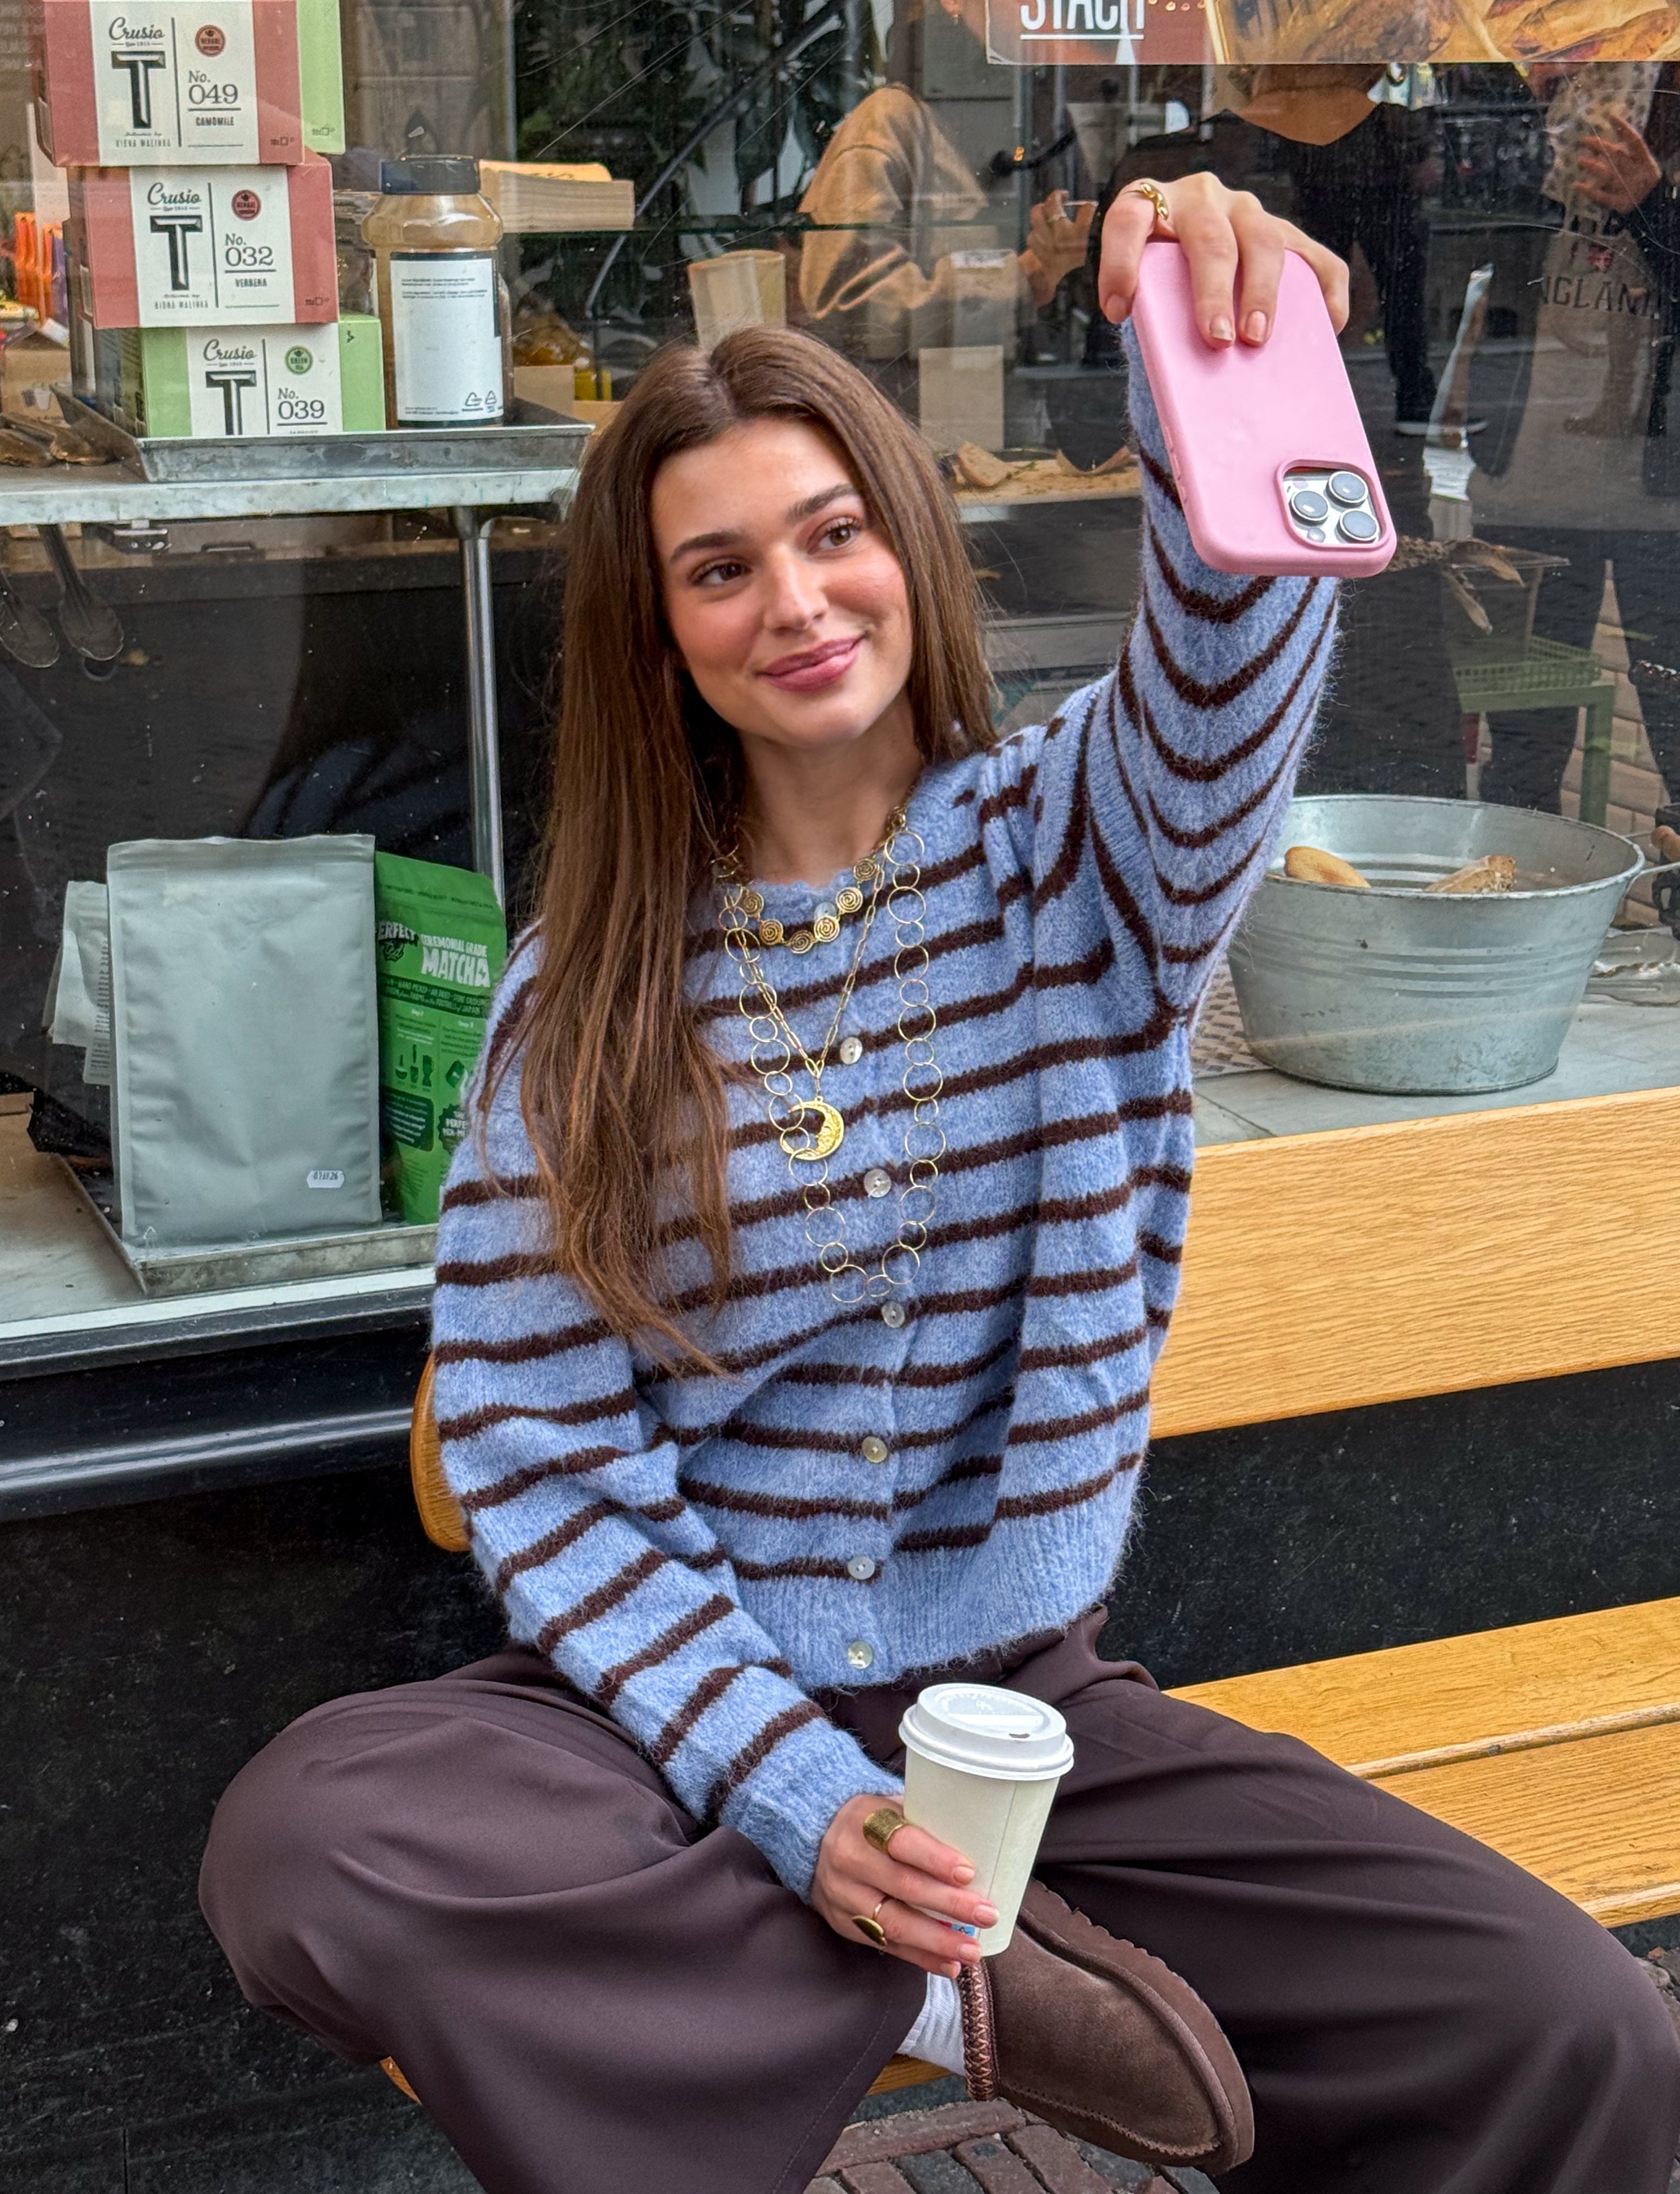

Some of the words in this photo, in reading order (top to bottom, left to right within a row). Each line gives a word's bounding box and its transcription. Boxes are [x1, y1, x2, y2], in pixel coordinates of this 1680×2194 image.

[109, 16, 165, 40] Crusio
[188, 70, 211, 83] No.
[111, 50, 166, 129] T
[188, 84, 239, 105] 049
[148, 182, 202, 205] Crusio
[225, 233, 247, 245] No.
[150, 215, 203, 291] T
[225, 246, 275, 267] 032
[204, 339, 257, 361] Crusio
[205, 370, 257, 435] T
[278, 387, 299, 399] No.
[278, 400, 325, 420] 039
[375, 920, 416, 941] ERFECT
[421, 947, 490, 987] MATCHA
